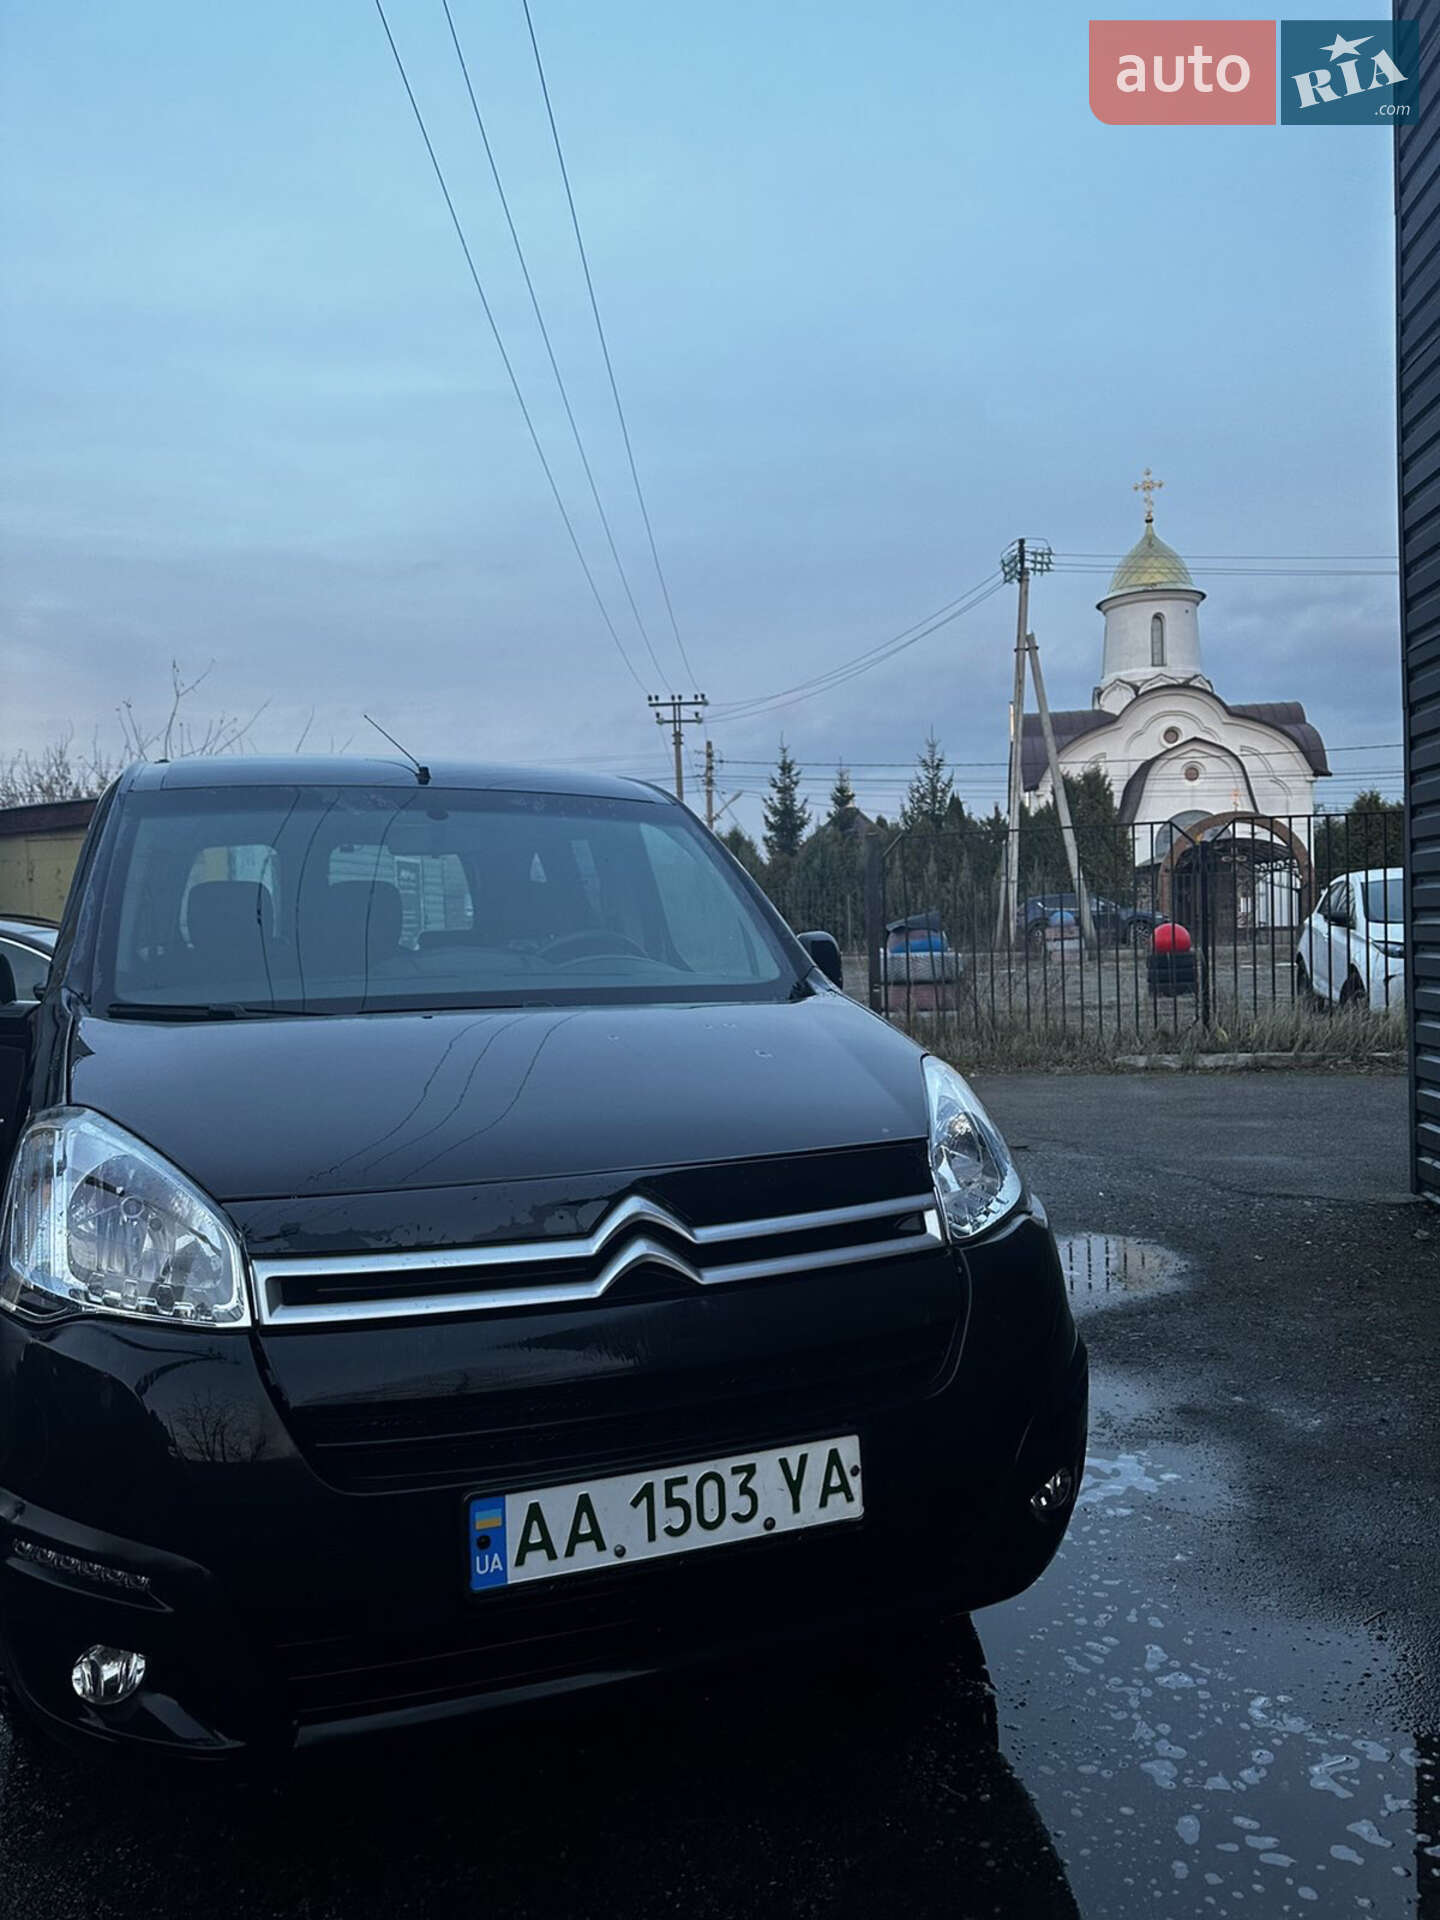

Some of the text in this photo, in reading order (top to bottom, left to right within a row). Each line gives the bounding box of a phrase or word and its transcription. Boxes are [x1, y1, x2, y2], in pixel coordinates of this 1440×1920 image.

[514, 1448, 855, 1566] AA 1503 YA
[475, 1554, 503, 1575] UA
